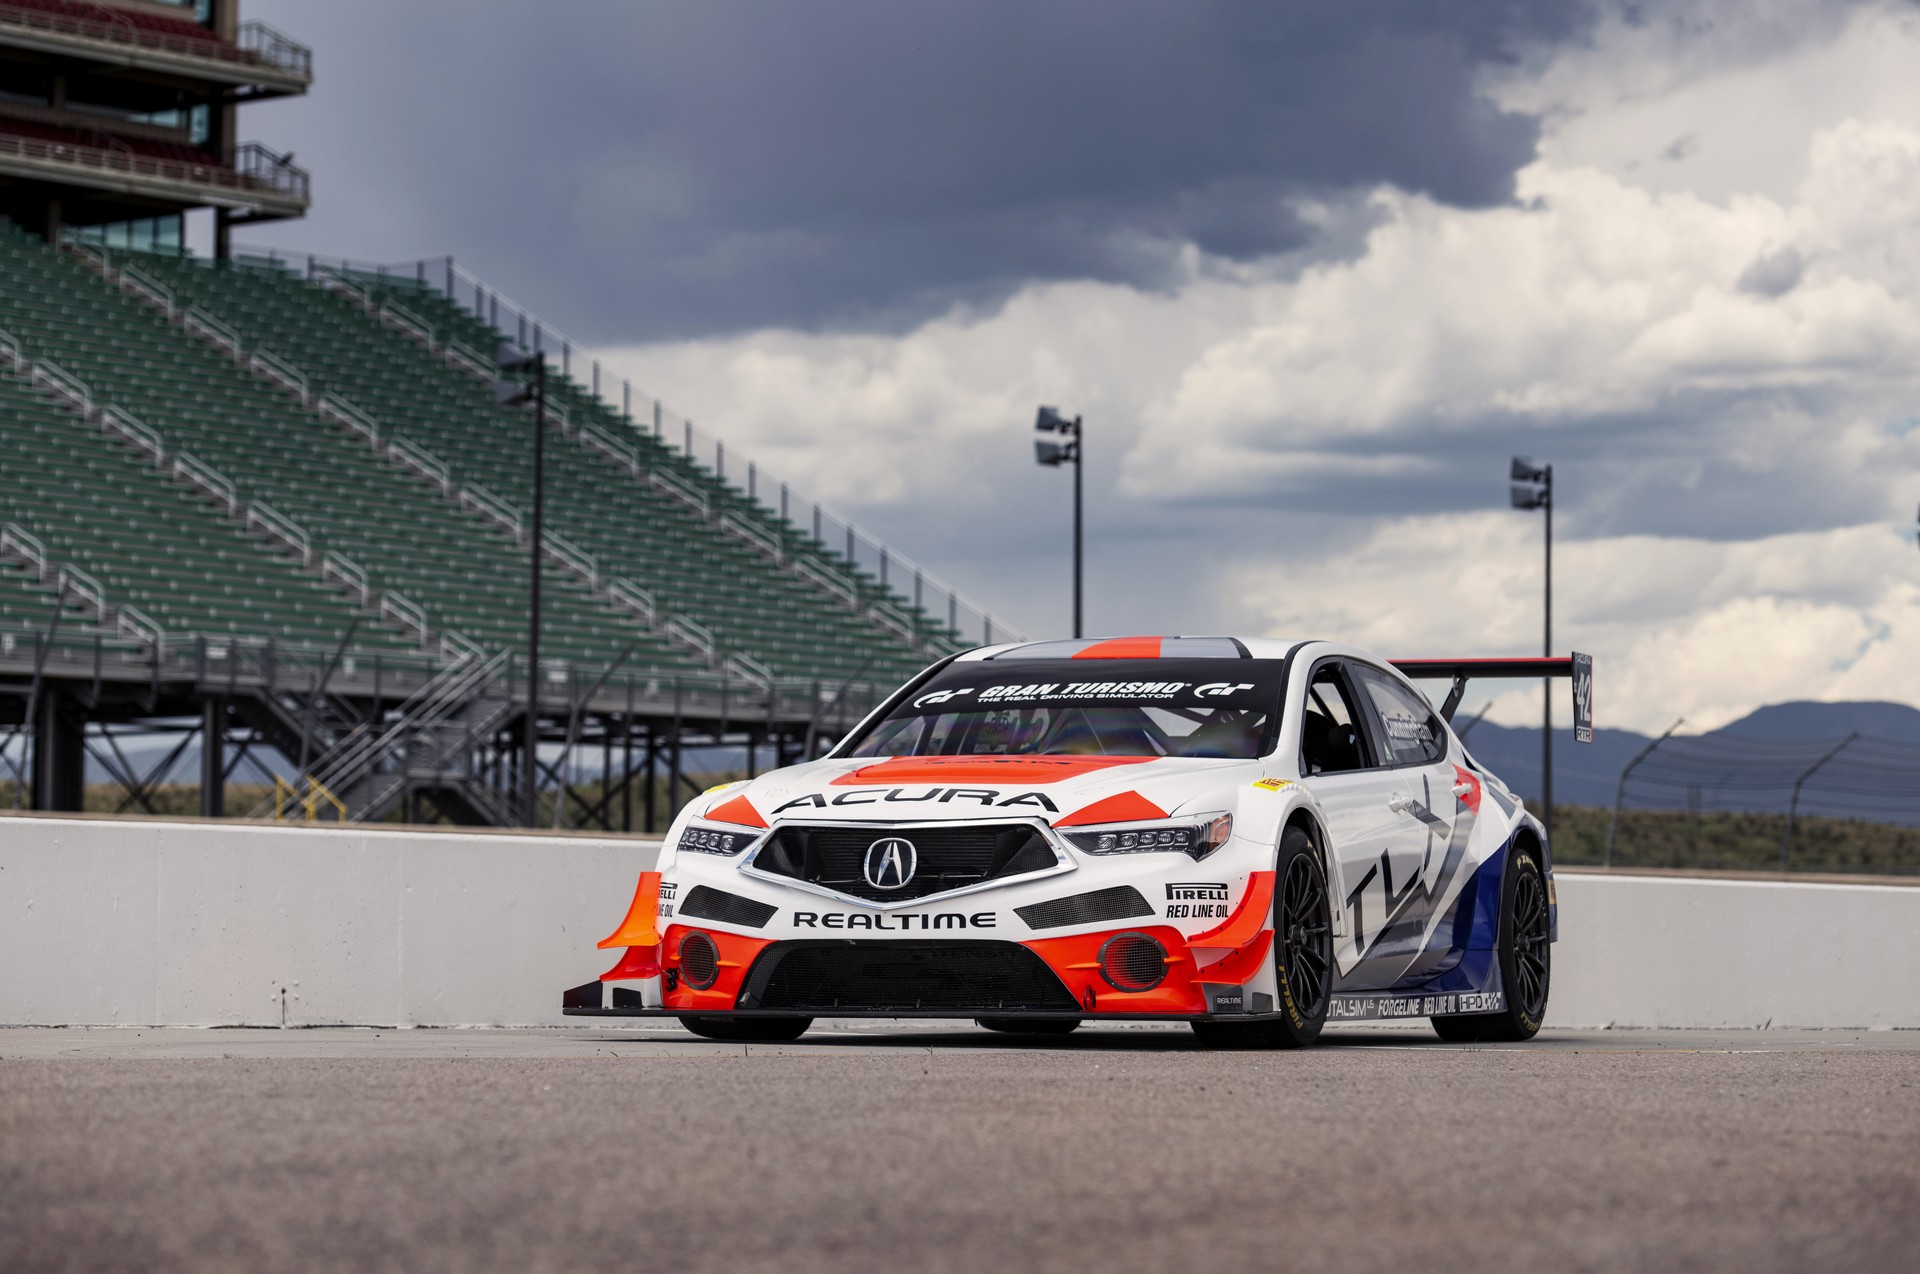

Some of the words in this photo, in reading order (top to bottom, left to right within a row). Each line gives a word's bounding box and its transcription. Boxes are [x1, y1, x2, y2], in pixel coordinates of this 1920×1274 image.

[979, 683, 1061, 698] GRAN
[1060, 682, 1185, 695] TURISMO
[1576, 672, 1591, 721] 42
[1577, 727, 1591, 741] RTR
[770, 788, 1060, 815] ACURA
[1165, 883, 1228, 900] PIRELLI
[1166, 905, 1189, 918] RED
[1192, 904, 1214, 918] LINE
[1215, 904, 1229, 918] OIL
[793, 911, 997, 930] REALTIME
[1216, 996, 1242, 1004] REALTIME
[1278, 965, 1304, 1029] PIRELLI
[1423, 996, 1435, 1015] RED
[1435, 996, 1447, 1014] LINE
[1447, 995, 1456, 1013] OIL
[1460, 995, 1483, 1010] HPD
[1377, 998, 1420, 1017] FORGELINE
